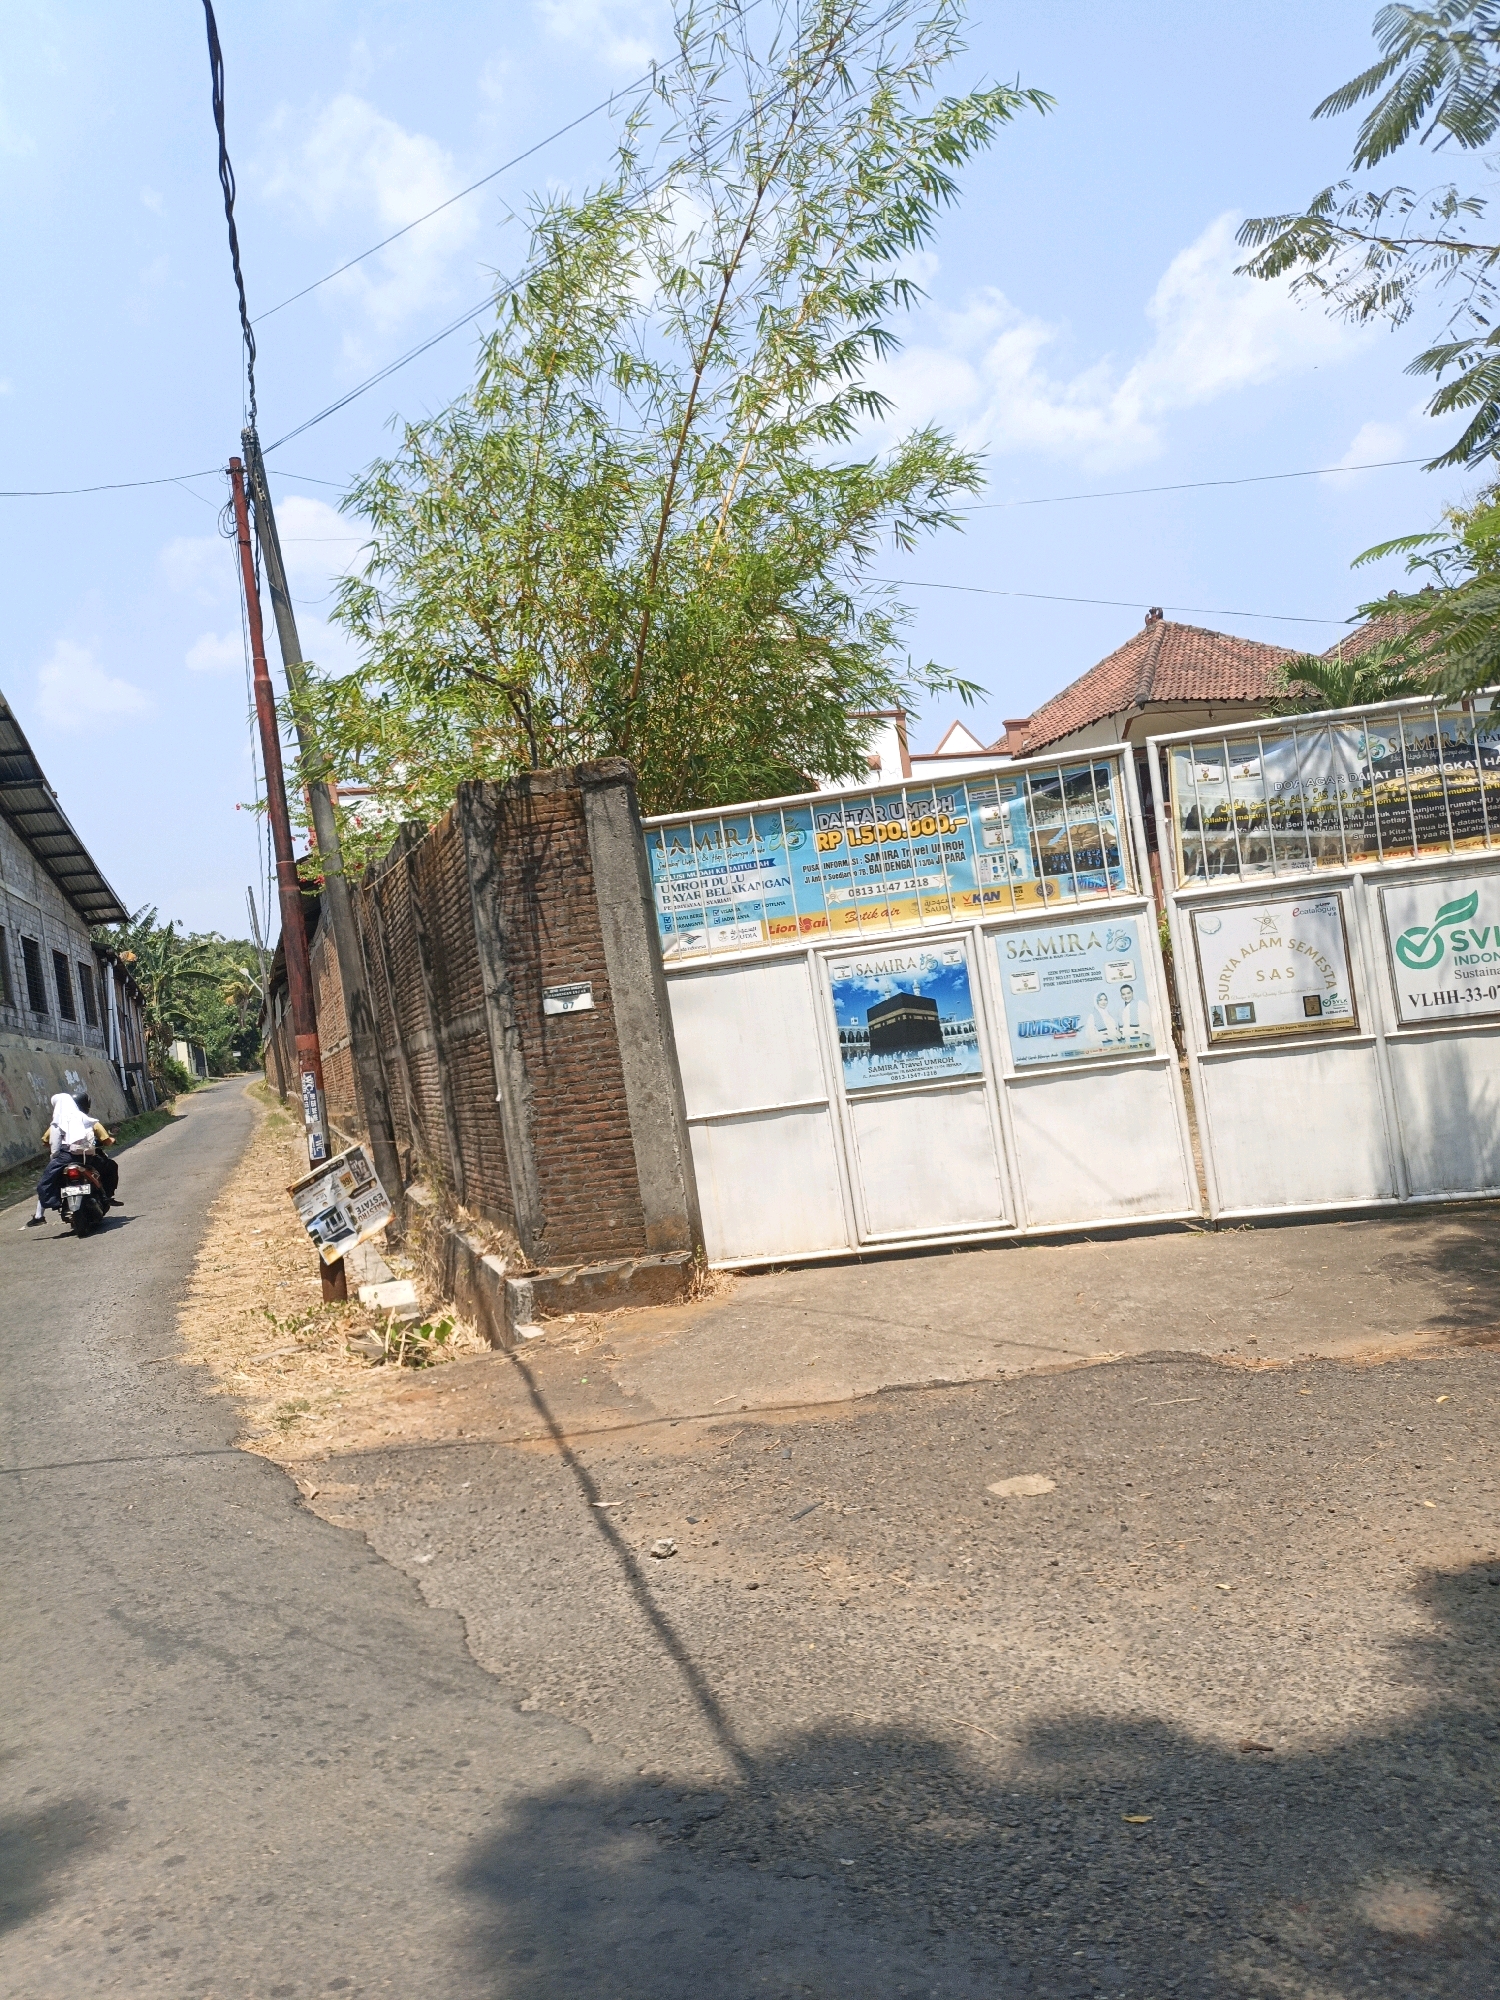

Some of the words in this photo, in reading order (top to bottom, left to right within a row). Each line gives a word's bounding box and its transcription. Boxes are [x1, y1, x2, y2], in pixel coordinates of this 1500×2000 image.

[1388, 731, 1469, 753] SAMIRA
[1274, 780, 1304, 791] DOA
[1306, 774, 1346, 787] AGAR
[1349, 770, 1392, 783] DAPAT
[1395, 760, 1480, 778] BERANGKAT
[817, 805, 886, 831] DAFTAR
[889, 794, 955, 820] UMROH
[655, 825, 763, 858] SAMIRA
[1353, 831, 1387, 841] Semoa
[823, 858, 859, 870] INFORMSI
[864, 849, 900, 864] SAMIRA
[931, 839, 965, 853] UMROH
[661, 879, 708, 894] UMROH
[712, 873, 745, 887] DULU
[662, 890, 702, 904] BAYAR
[706, 876, 791, 898] BELAKANGAN
[848, 886, 874, 898] 0813
[904, 877, 929, 889] 1218
[973, 890, 1000, 903] KAN
[769, 923, 797, 935] Lion
[1006, 931, 1103, 960] SAMIRA
[856, 957, 917, 976] SAMIRA
[1218, 958, 1241, 1001] SURYA
[1240, 937, 1282, 959] ALAM
[1288, 938, 1337, 990] SEMESTA
[563, 1001, 575, 1010] 07
[868, 1063, 899, 1074] SAMIRA
[900, 1060, 923, 1069] Travel
[924, 1056, 955, 1066] UMROH
[315, 1140, 324, 1152] WC
[355, 1193, 384, 1215] ESTATE
[357, 1199, 389, 1222] MAESTRO
